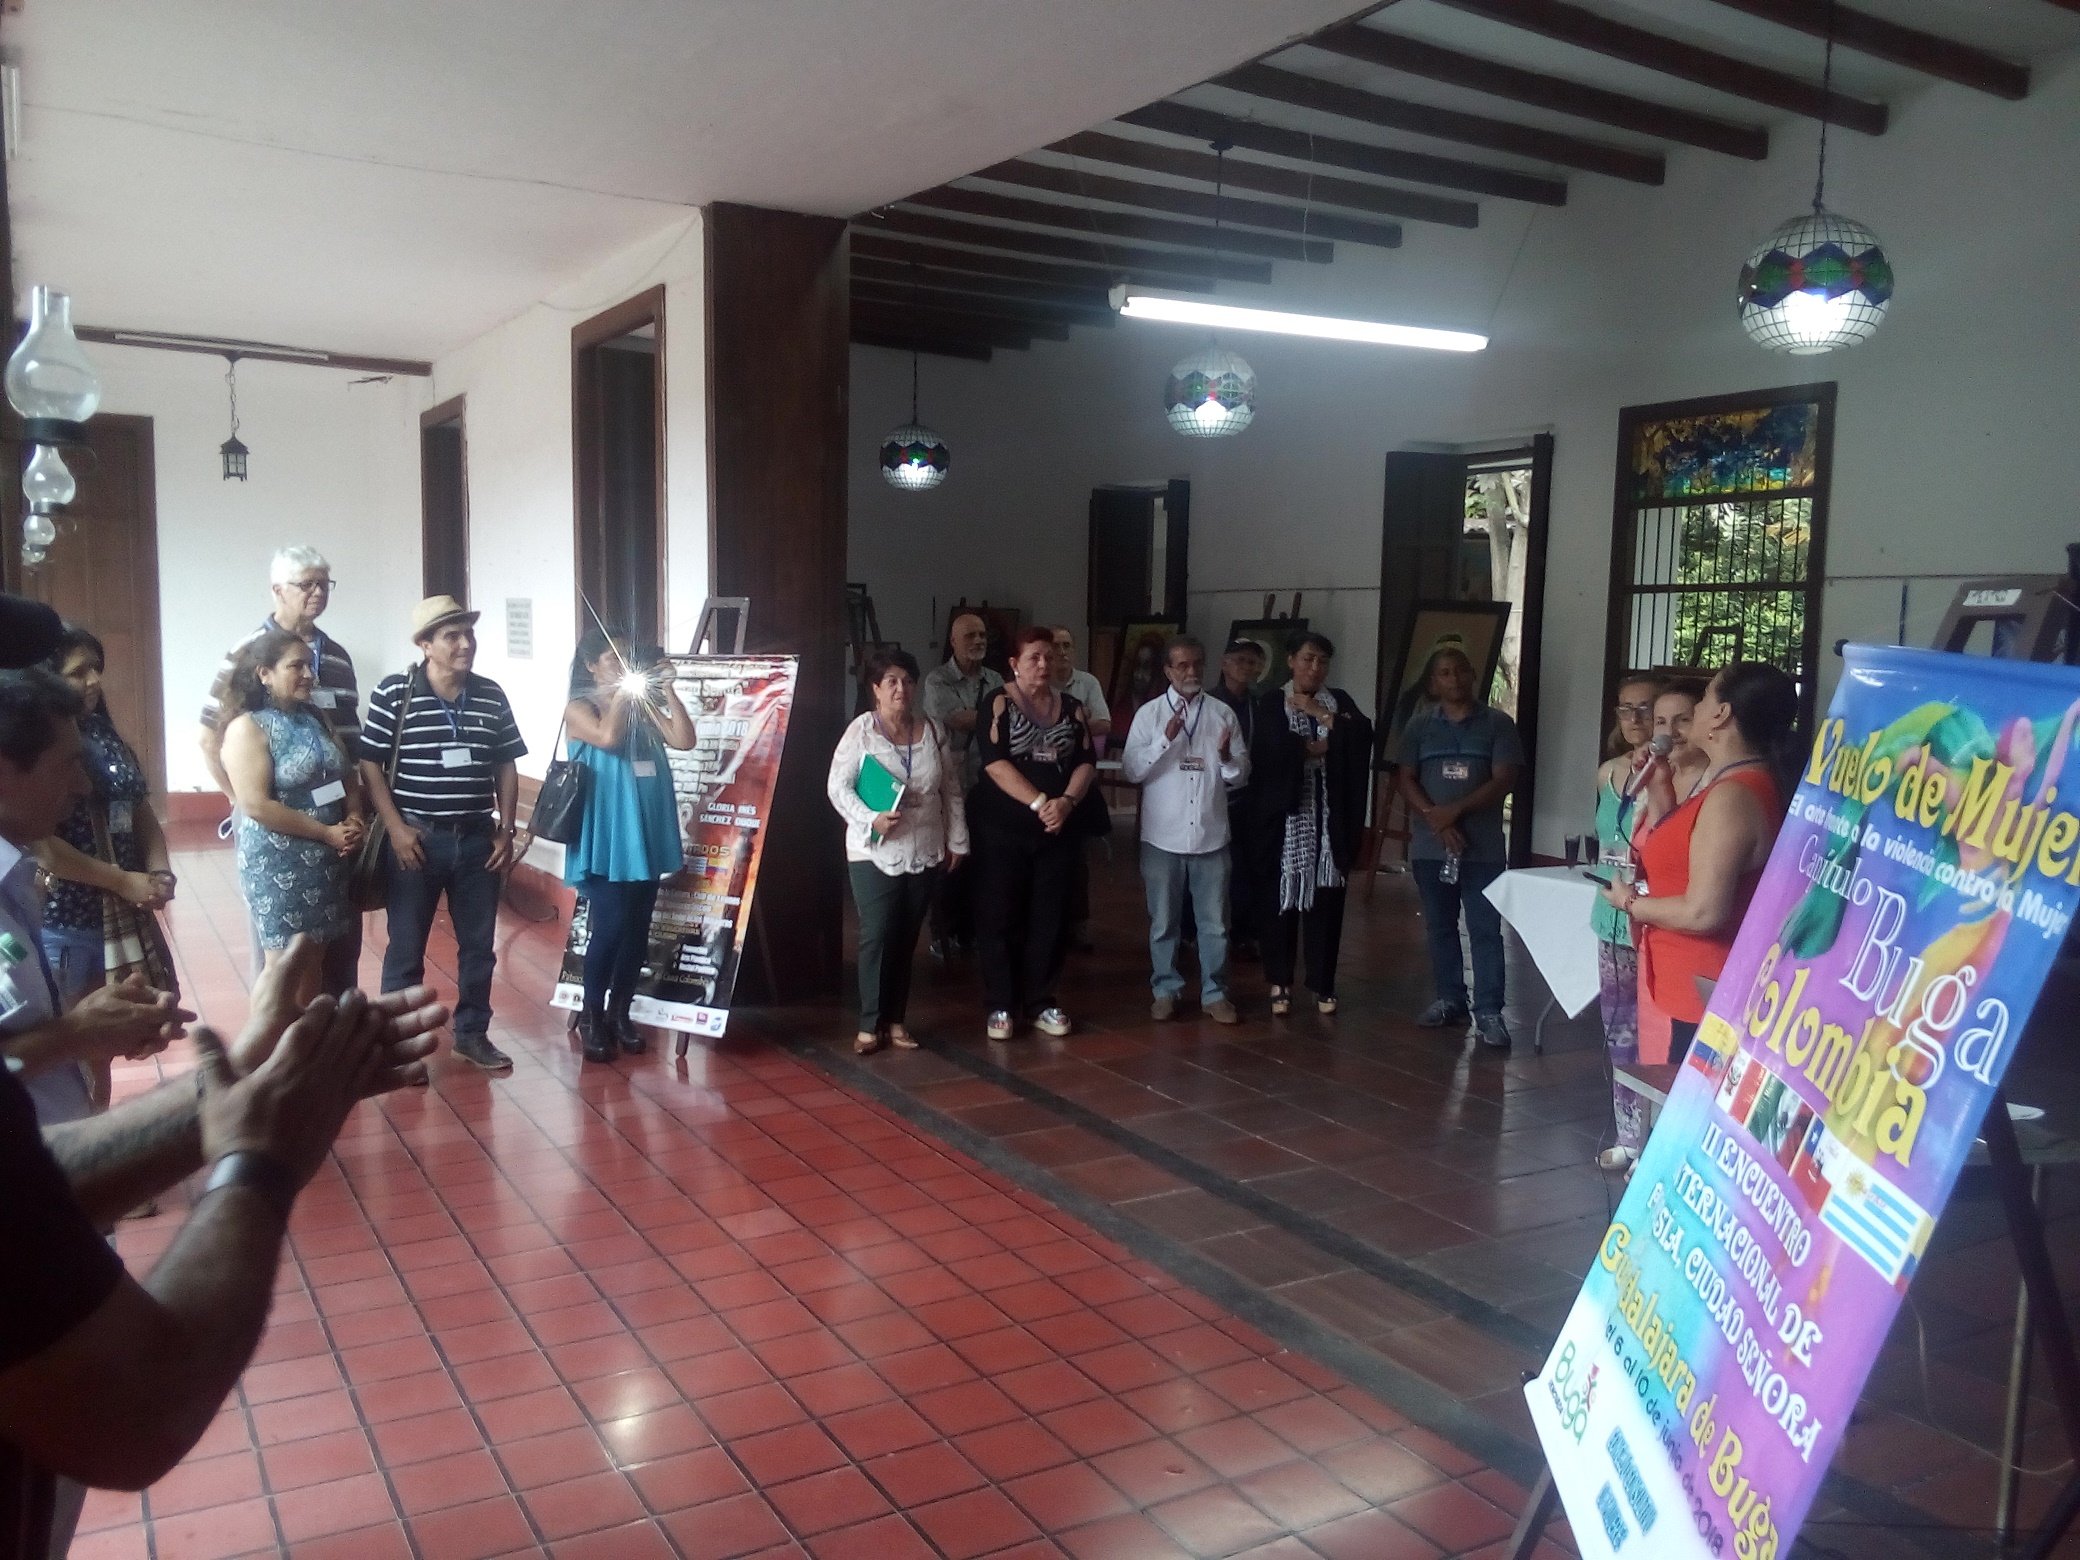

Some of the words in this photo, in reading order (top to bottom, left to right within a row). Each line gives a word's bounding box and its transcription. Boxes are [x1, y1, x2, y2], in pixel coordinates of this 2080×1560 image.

[1805, 718, 1893, 805] Vuelo
[1895, 742, 1947, 829] de
[1788, 793, 1804, 817] El
[1851, 824, 1860, 843] a
[1860, 823, 1881, 852] la
[1935, 861, 1995, 903] contra
[1995, 880, 2015, 913] la
[1839, 885, 2009, 1090] Buga
[1743, 943, 1927, 1168] Colombia
[1673, 1160, 1783, 1327] TERNACIONAL
[1777, 1302, 1824, 1368] DE
[1716, 1137, 1812, 1268] ENCUENTRO
[1555, 1339, 1588, 1446] Buga
[1614, 1335, 1624, 1356] 6
[1623, 1355, 1638, 1378] al
[1634, 1368, 1649, 1398] 10
[1646, 1398, 1661, 1426] de
[1684, 1246, 1745, 1345] CIUDAD
[1736, 1326, 1823, 1463] SEÑORA
[1690, 1393, 1719, 1458] de
